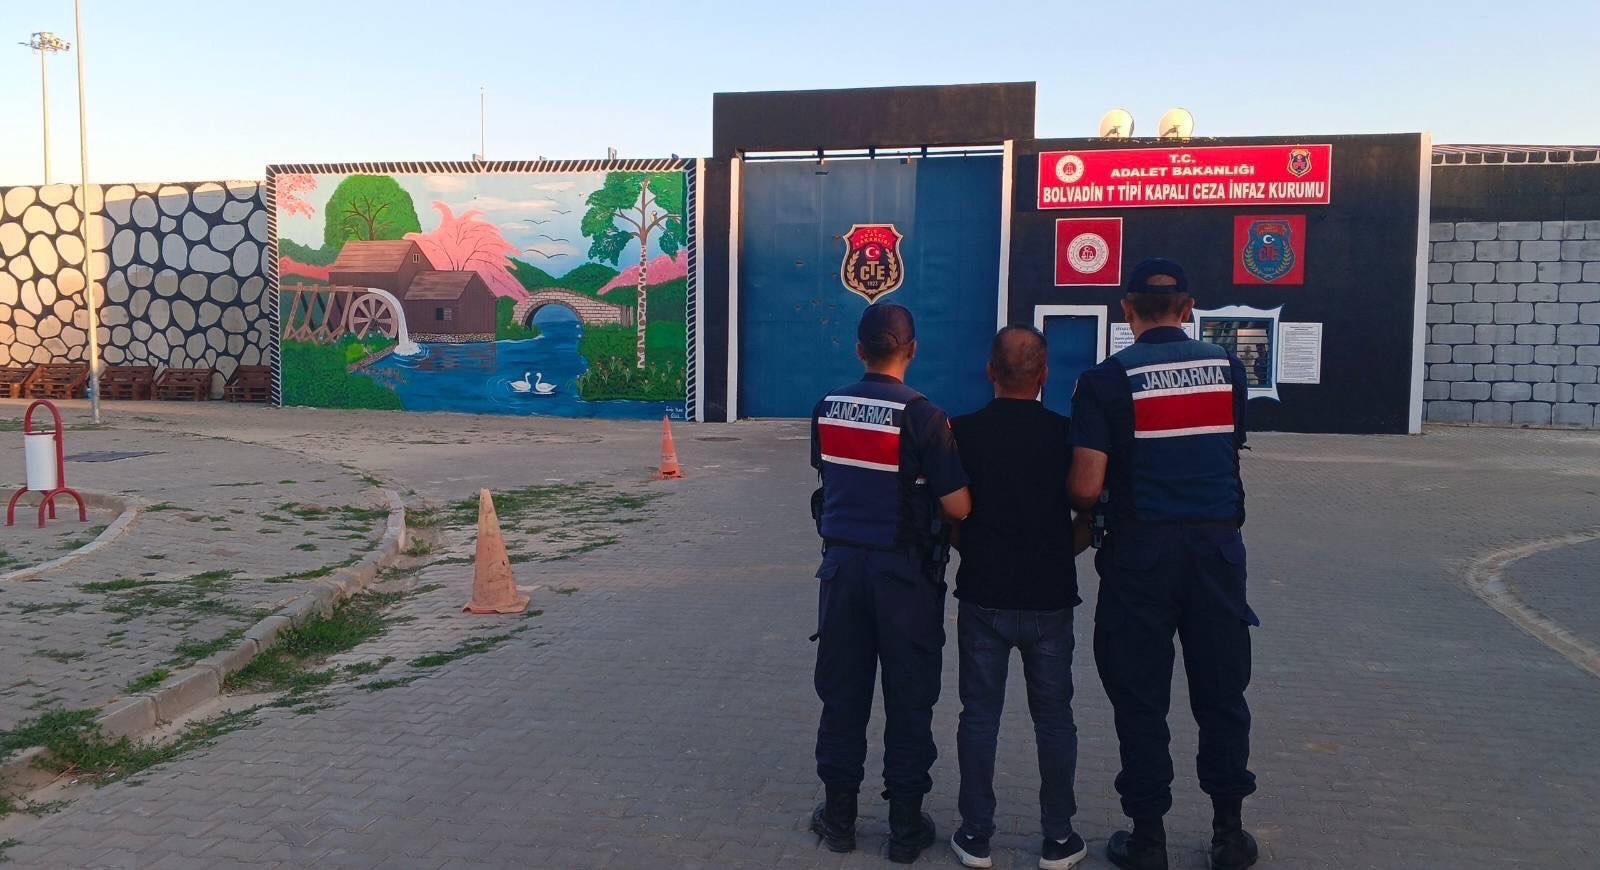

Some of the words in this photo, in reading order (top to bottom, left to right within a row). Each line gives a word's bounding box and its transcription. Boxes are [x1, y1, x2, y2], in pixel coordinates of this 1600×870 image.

[1169, 154, 1196, 164] T.C.
[1110, 167, 1168, 178] ADALET
[1172, 164, 1255, 177] BAKANLIĞI
[1043, 182, 1103, 203] BOLVADİN
[1106, 185, 1115, 201] T
[1117, 181, 1142, 201] TİPİ
[1145, 184, 1190, 201] KAPALI
[1193, 183, 1226, 200] CEZA
[1229, 179, 1265, 200] İNFAZ
[1268, 181, 1325, 199] KURUMU
[860, 260, 885, 280] CTE
[1142, 366, 1226, 390] JANDARMA
[826, 401, 894, 426] JANDARMA
